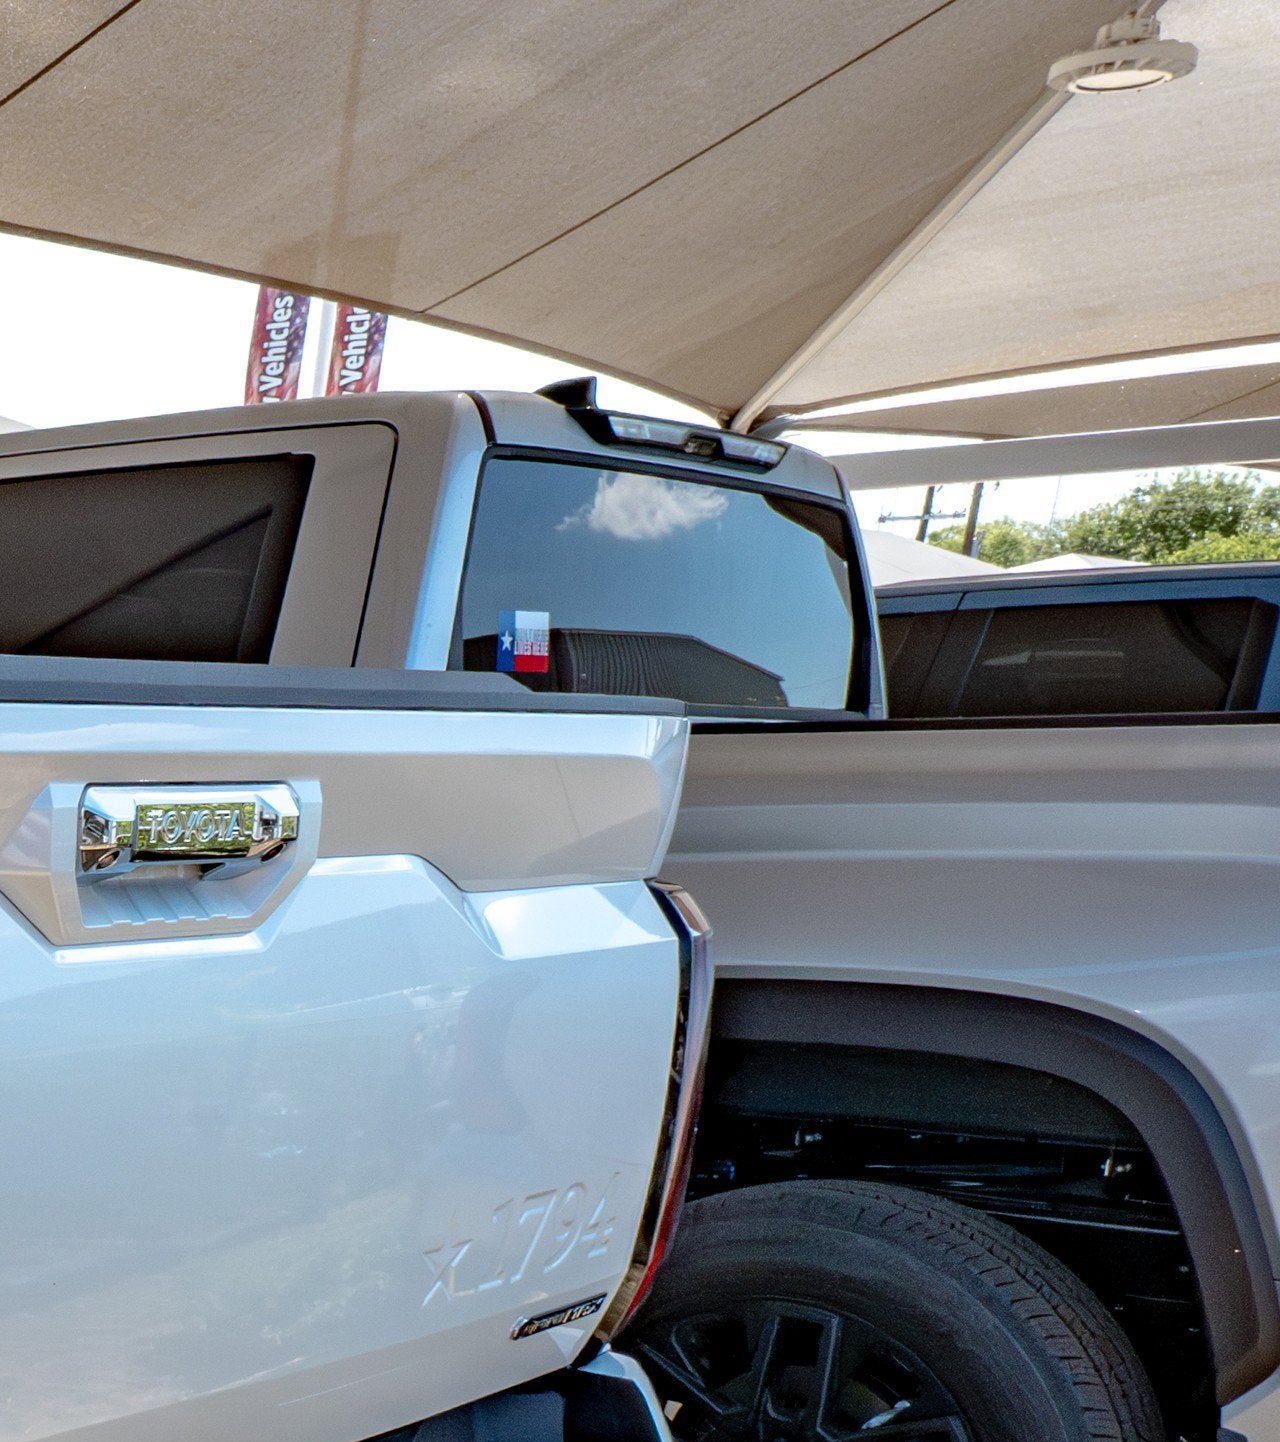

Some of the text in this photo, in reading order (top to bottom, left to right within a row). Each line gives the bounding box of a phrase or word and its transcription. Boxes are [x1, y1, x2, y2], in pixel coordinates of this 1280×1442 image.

[259, 294, 294, 392] Vehicles
[339, 307, 372, 387] Vehicl
[146, 808, 245, 844] TOYOTA
